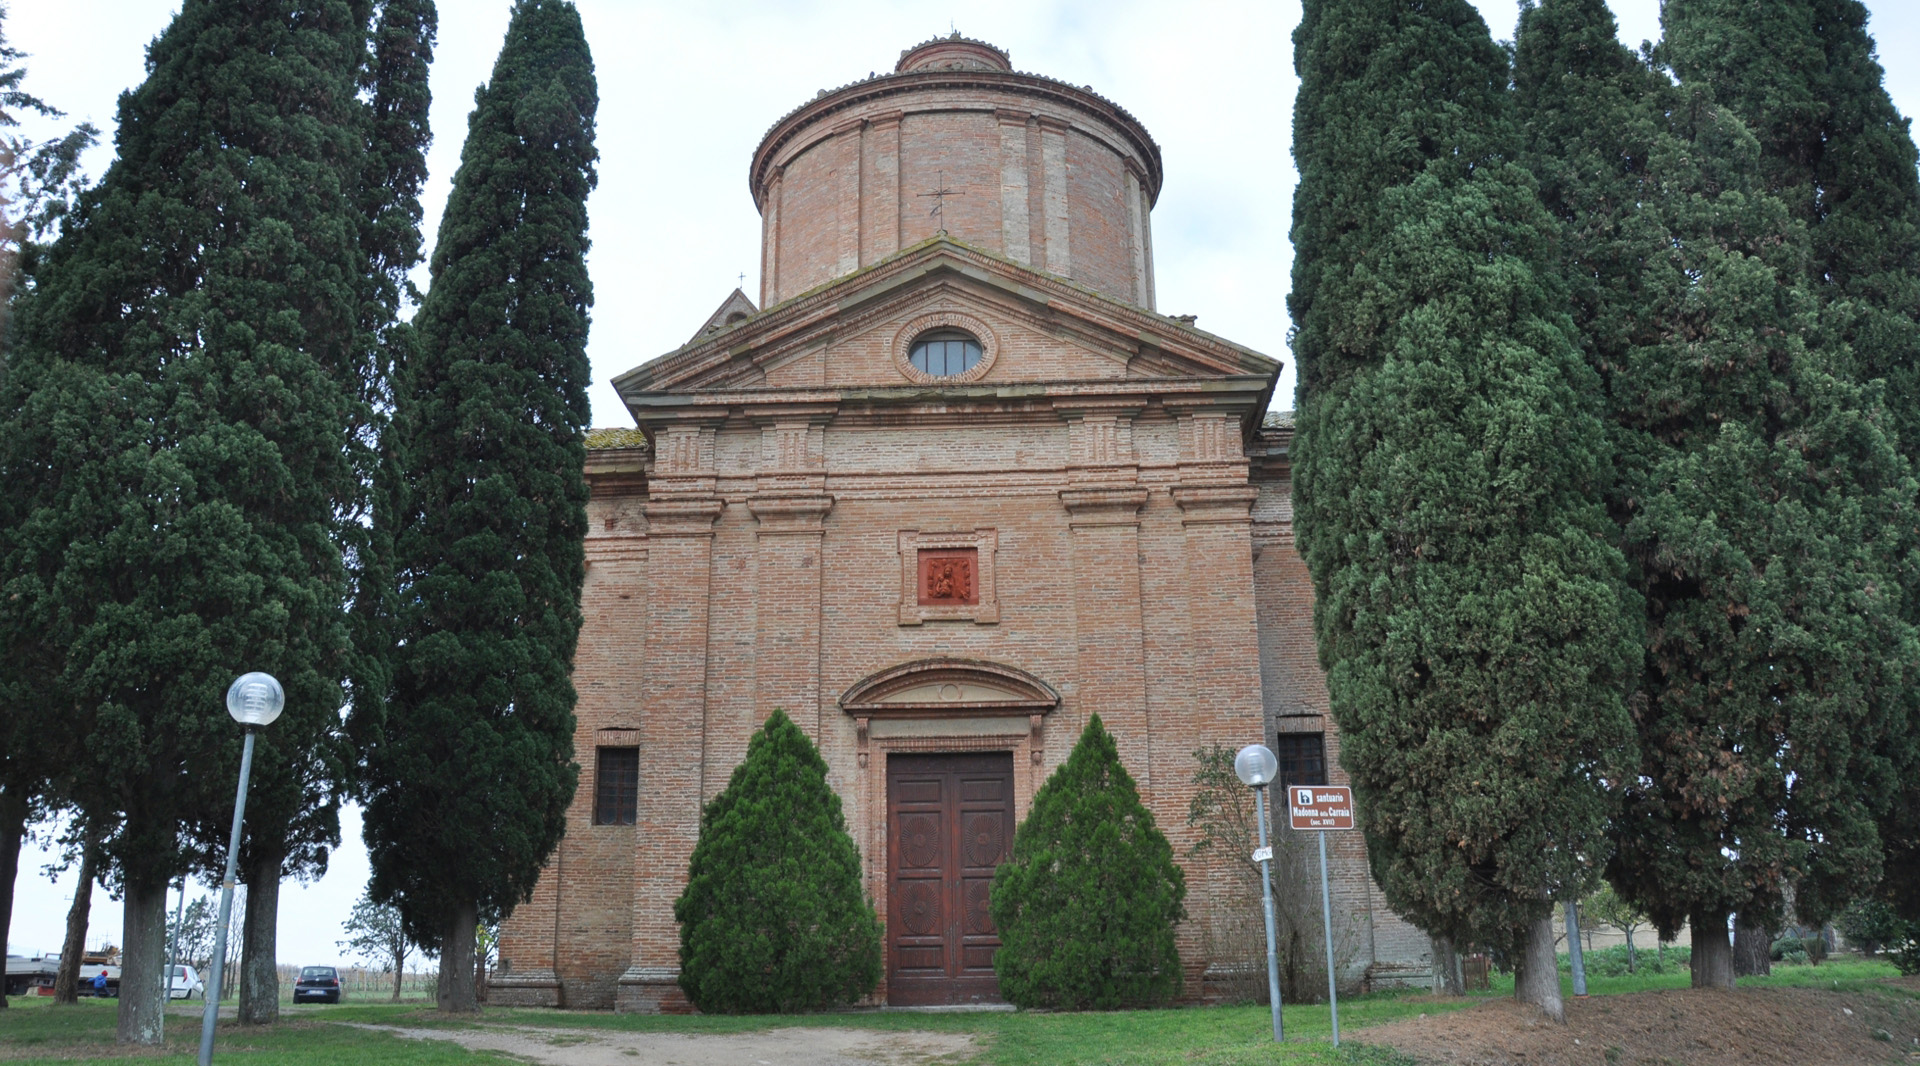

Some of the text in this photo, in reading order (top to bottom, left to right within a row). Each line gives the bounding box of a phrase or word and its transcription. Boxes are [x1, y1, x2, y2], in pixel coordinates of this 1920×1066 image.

[1316, 792, 1344, 803] santuario
[1293, 806, 1319, 817] Madonna
[1328, 806, 1350, 817] Carraia
